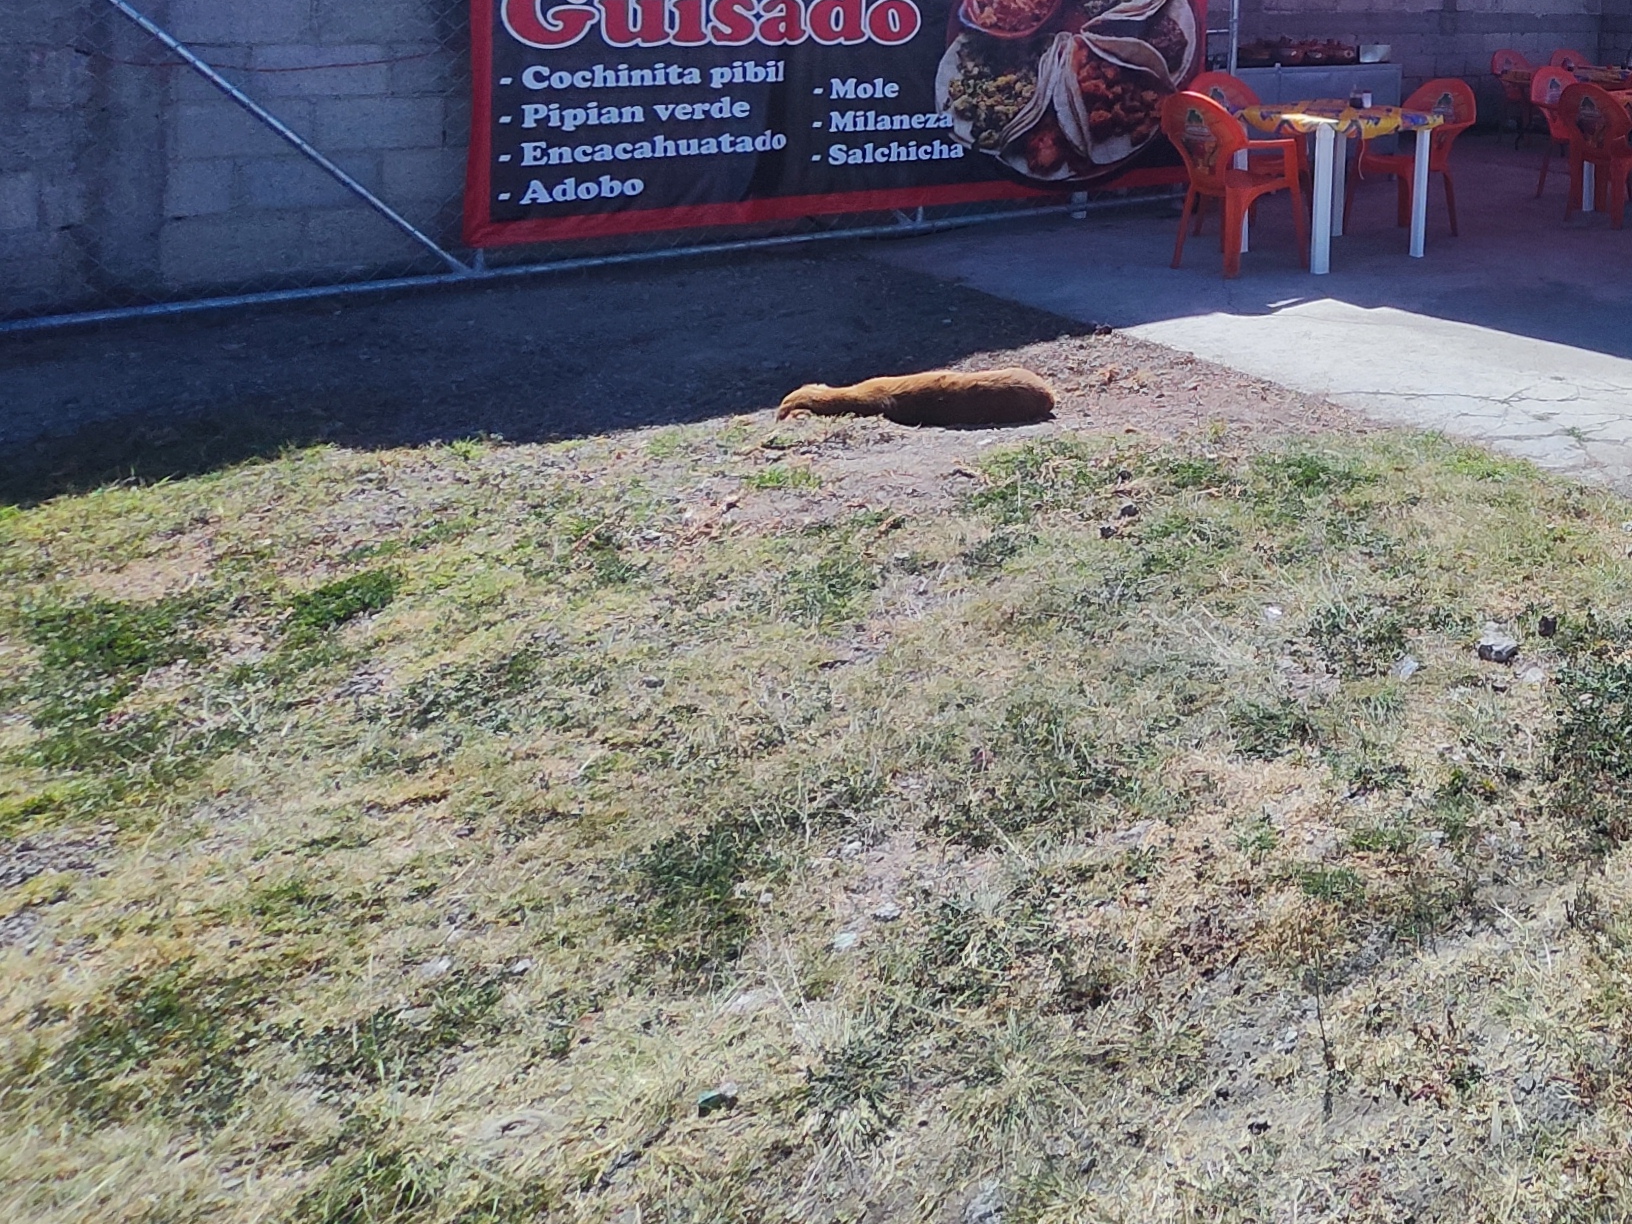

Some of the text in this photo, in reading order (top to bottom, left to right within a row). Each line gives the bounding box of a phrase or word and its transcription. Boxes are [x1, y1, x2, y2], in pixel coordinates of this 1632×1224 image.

[521, 60, 786, 90] Cochinita pibil
[829, 77, 900, 99] Mole
[520, 97, 751, 131] Pipian verde
[828, 110, 954, 133] Milaneza
[520, 130, 787, 167] Encacahuatado
[828, 139, 965, 165] Salchicha
[518, 175, 645, 205] Adobo
